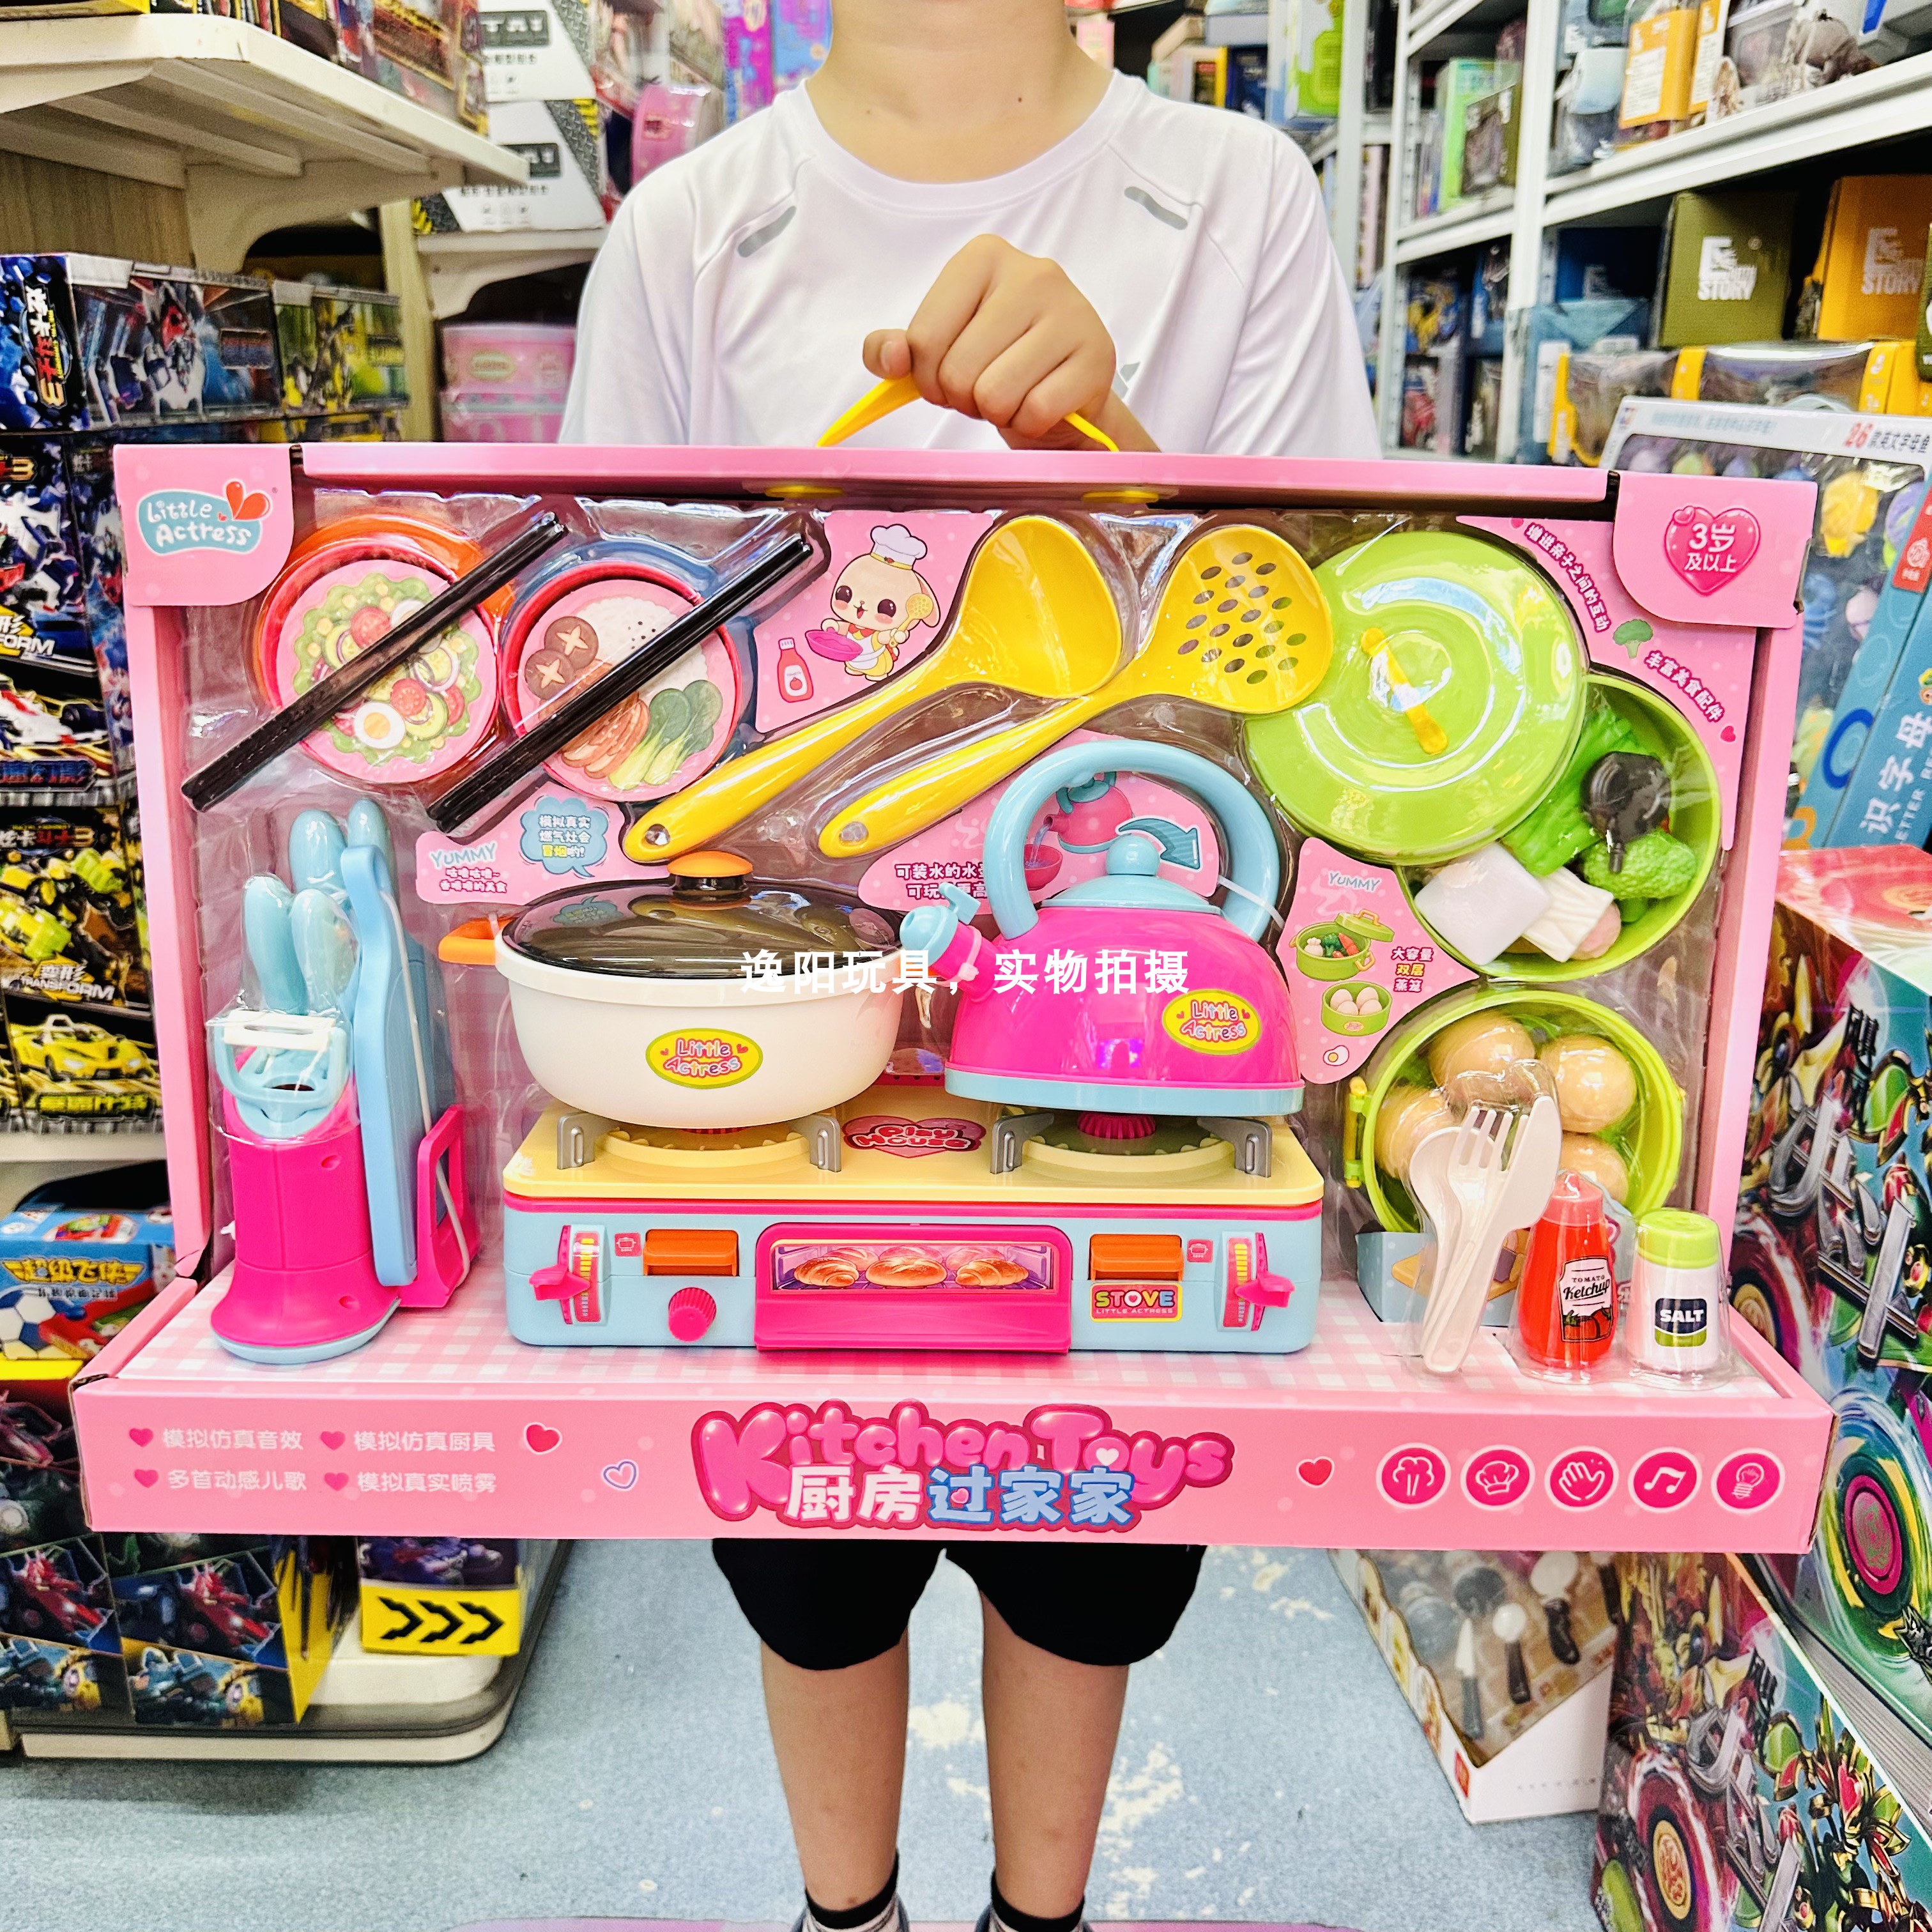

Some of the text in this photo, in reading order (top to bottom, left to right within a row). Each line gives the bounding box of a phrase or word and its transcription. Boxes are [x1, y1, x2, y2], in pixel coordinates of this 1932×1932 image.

[148, 500, 213, 523] Little
[156, 521, 252, 547] Actress
[1689, 523, 1736, 553] 3岁
[1683, 552, 1737, 573] 及以上
[1525, 523, 1611, 632] 增进亲子之间的互动
[1644, 650, 1724, 723] 丰富美食配件
[539, 814, 592, 829] 模拟真实
[1894, 788, 1926, 844] ETTER
[539, 829, 592, 843] 燃气灶会
[431, 843, 496, 867] YUMMY
[907, 882, 988, 900] 可玩更高
[1328, 872, 1381, 893] YUMMY
[1391, 946, 1434, 962] 大容量
[1395, 963, 1425, 977] 双层
[1393, 977, 1423, 992] 蒸笼
[1191, 1000, 1239, 1021] Little
[1181, 1020, 1247, 1042] Actress
[677, 1038, 732, 1058] Little
[664, 1055, 742, 1077] Actress
[875, 1125, 958, 1139] Play
[1563, 1278, 1611, 1300] Ketchup
[1572, 1275, 1606, 1283] TOMATO
[1094, 1289, 1176, 1308] STOVE
[1660, 1310, 1705, 1323] SALT
[162, 1428, 304, 1450] 模拟仿真音效
[353, 1430, 496, 1453] 模拟仿真厨具
[698, 1404, 1231, 1517] Kitchen Toys
[167, 1469, 307, 1491] 多首动感儿歌
[356, 1471, 498, 1494] 模拟真实喷雾
[783, 1463, 1136, 1528] 厨房过家家
